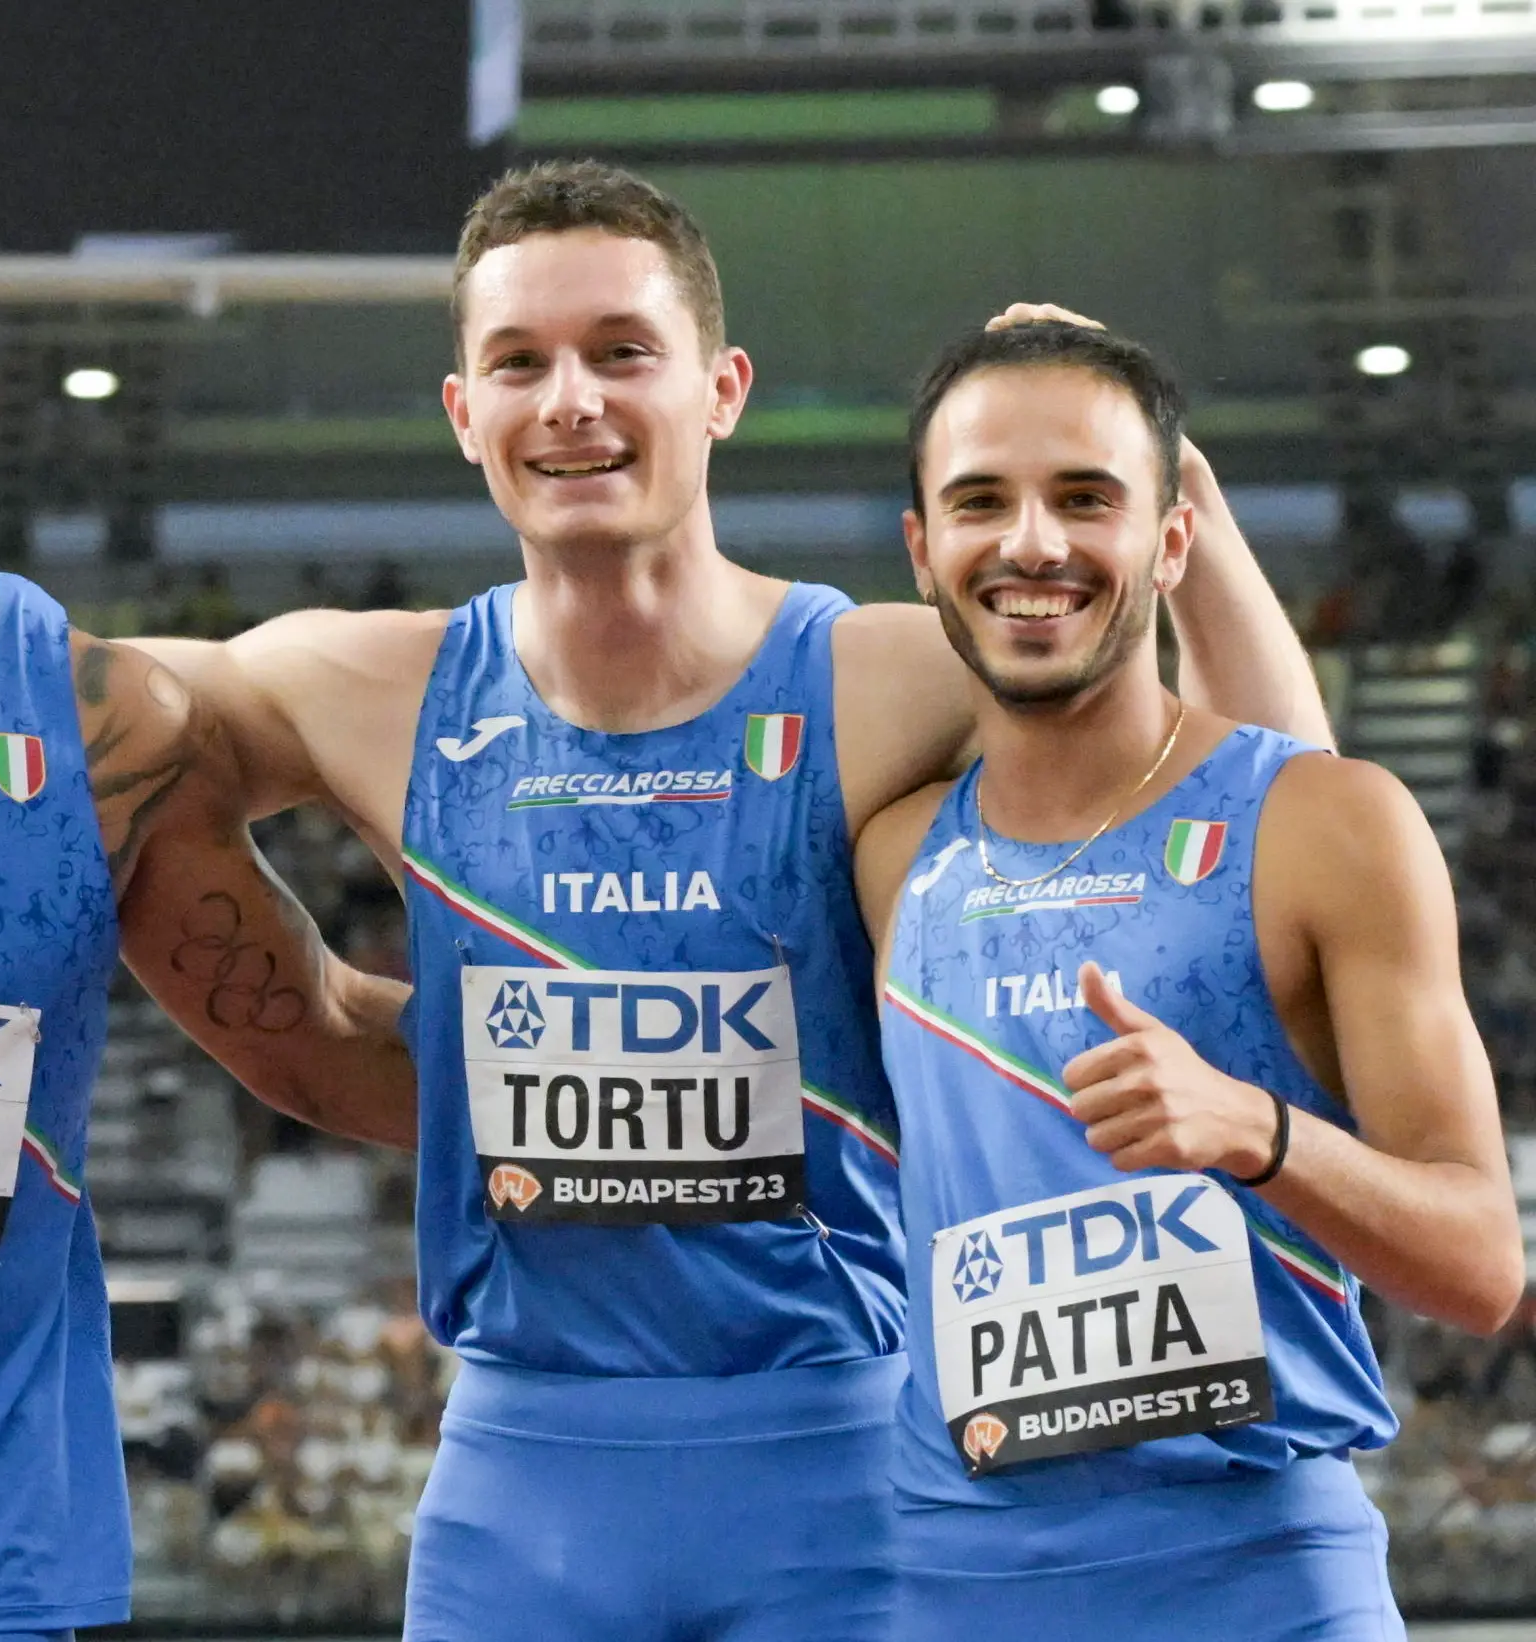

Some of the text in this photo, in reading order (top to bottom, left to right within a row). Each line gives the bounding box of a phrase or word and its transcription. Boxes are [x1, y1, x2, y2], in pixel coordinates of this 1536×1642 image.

[512, 769, 733, 798] FRECCIAROSSA
[543, 870, 721, 913] ITALIA
[546, 980, 778, 1053] TDK
[503, 1073, 751, 1151] TORTU
[553, 1174, 787, 1204] BUDAPEST 23
[1001, 1185, 1222, 1286] TDK
[970, 1282, 1208, 1398] PATTA
[1018, 1378, 1251, 1441] BUDAPEST 23
